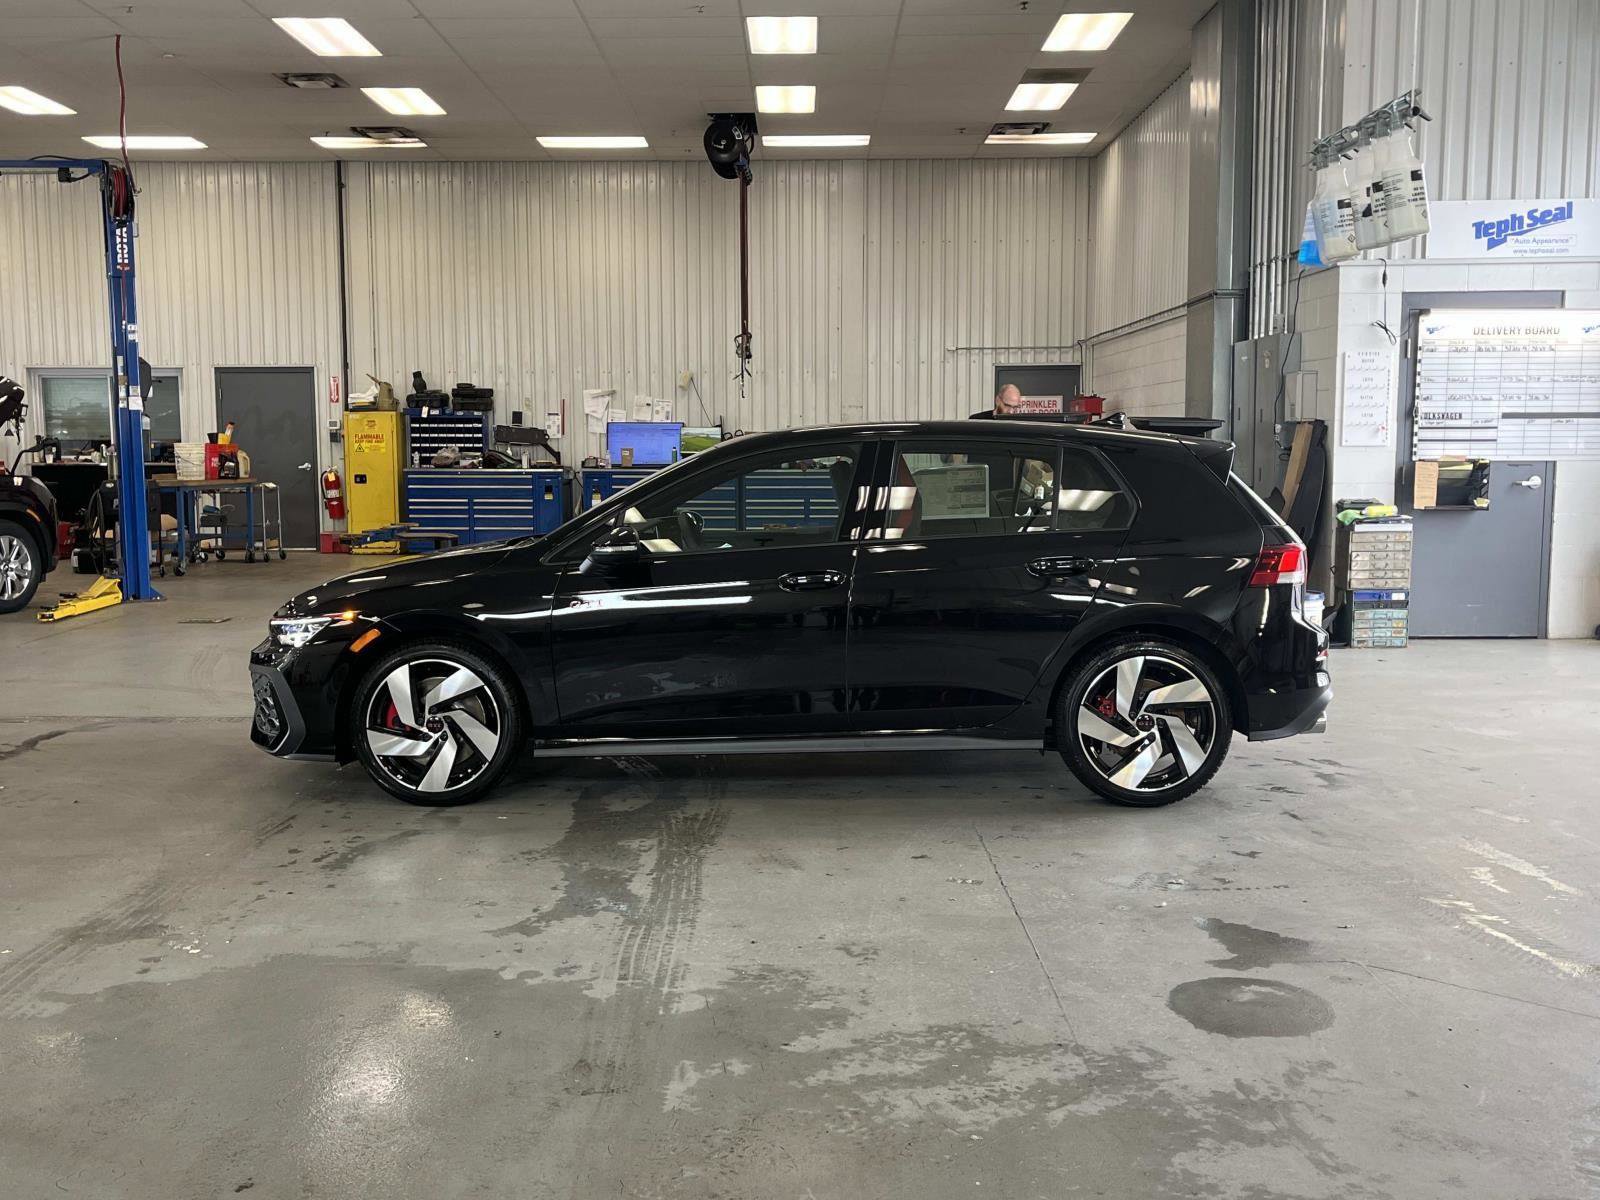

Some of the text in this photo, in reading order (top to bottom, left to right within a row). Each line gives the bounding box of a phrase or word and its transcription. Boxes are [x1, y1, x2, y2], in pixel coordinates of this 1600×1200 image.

[1472, 201, 1573, 239] Teph Seal
[115, 226, 129, 264] ROTA
[1473, 325, 1560, 336] DELIVERY BOARD
